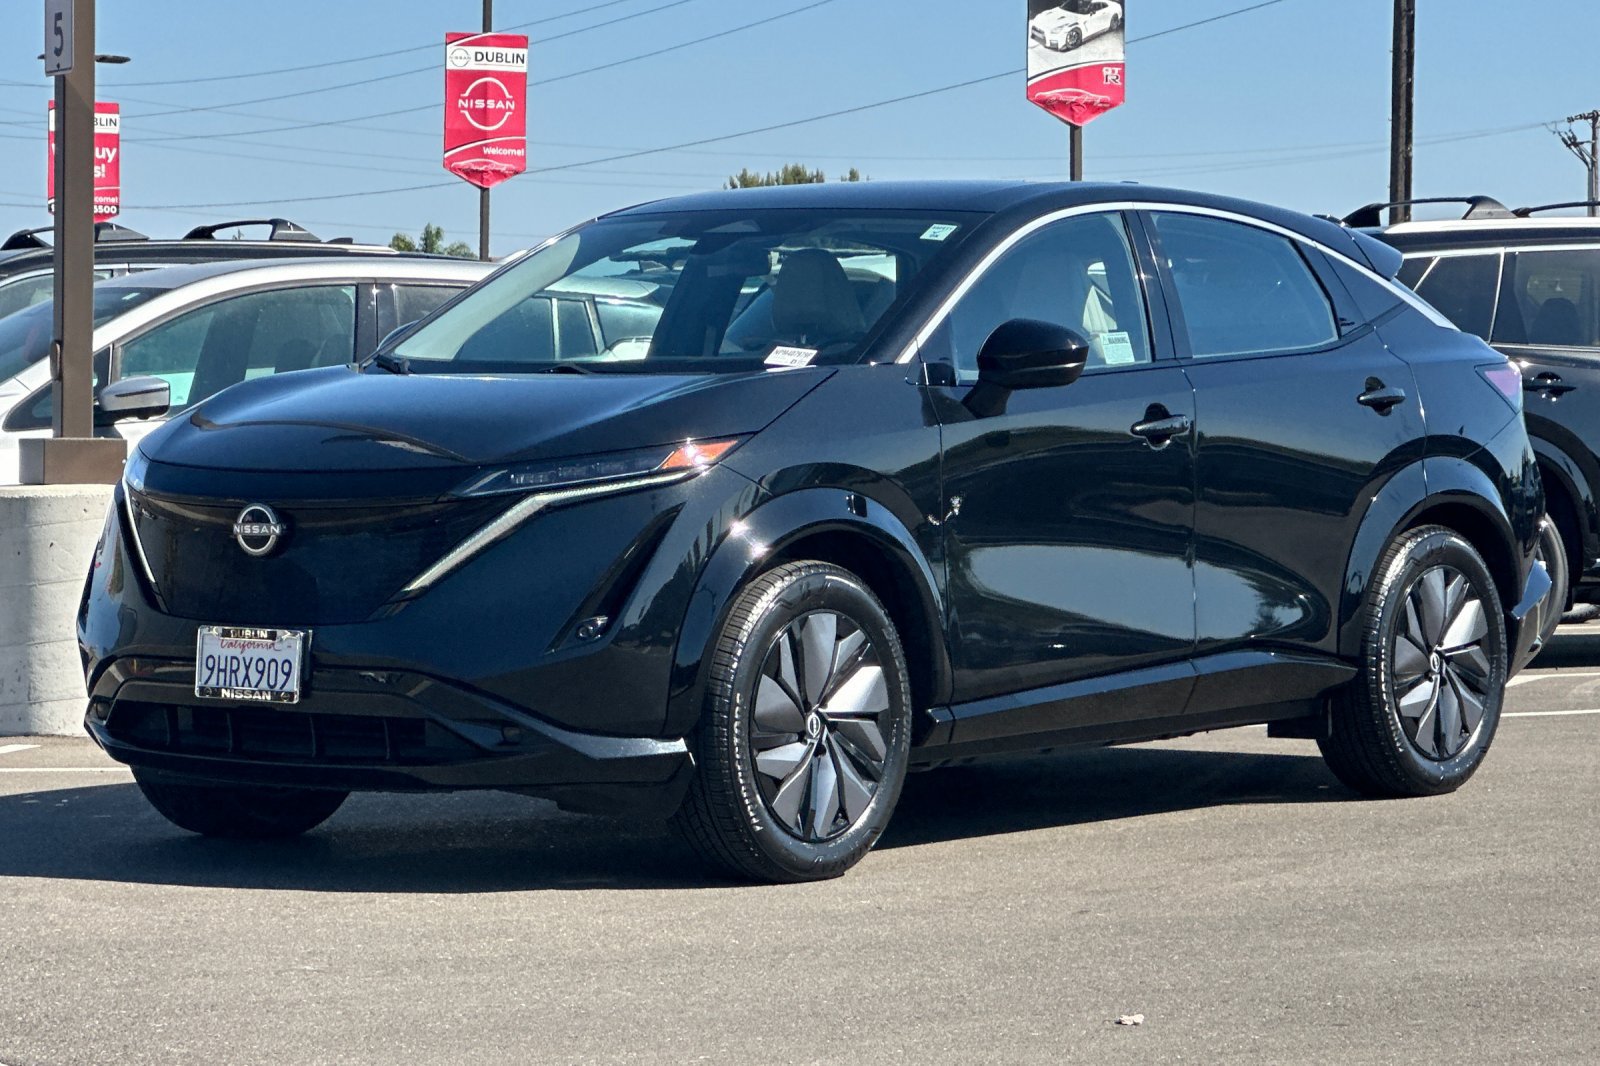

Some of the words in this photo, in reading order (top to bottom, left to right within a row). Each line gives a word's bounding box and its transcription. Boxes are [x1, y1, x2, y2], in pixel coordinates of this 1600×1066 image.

[54, 11, 64, 57] 5
[474, 51, 525, 64] DUBLIN
[458, 98, 515, 111] NISSAN
[93, 117, 117, 127] BLIN
[95, 146, 117, 163] uy
[483, 145, 525, 157] Welcome!
[233, 524, 280, 535] NISSAN
[230, 629, 268, 639] DUBLIN
[220, 638, 281, 654] California
[204, 654, 293, 690] 9HRX909
[221, 688, 271, 700] NISSAN
